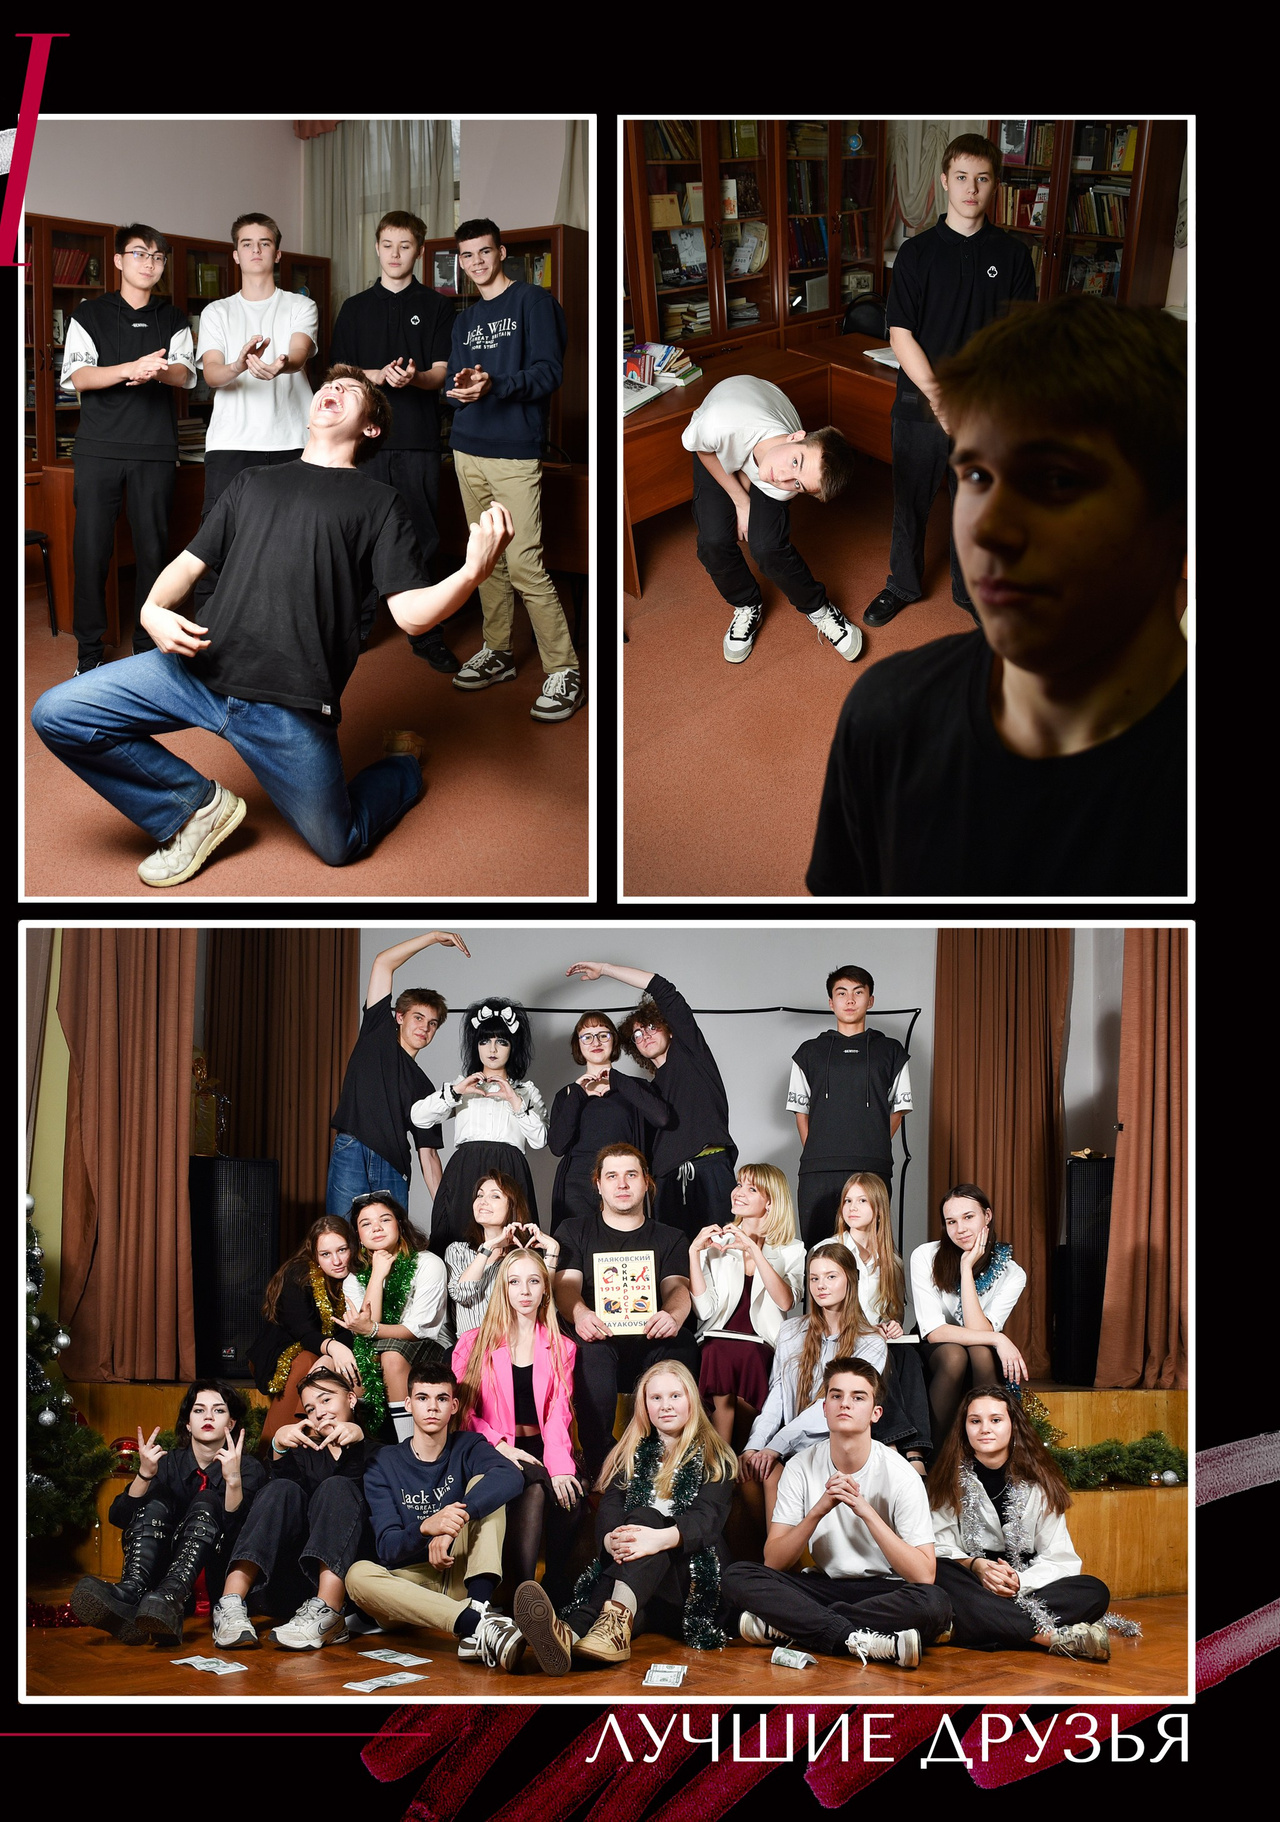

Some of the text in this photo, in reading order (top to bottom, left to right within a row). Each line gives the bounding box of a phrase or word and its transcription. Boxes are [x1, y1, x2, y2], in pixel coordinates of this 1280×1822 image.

[463, 318, 517, 346] Jck Wills
[598, 1254, 651, 1263] МАЯКОВСКИЙ
[401, 1488, 430, 1505] Jack
